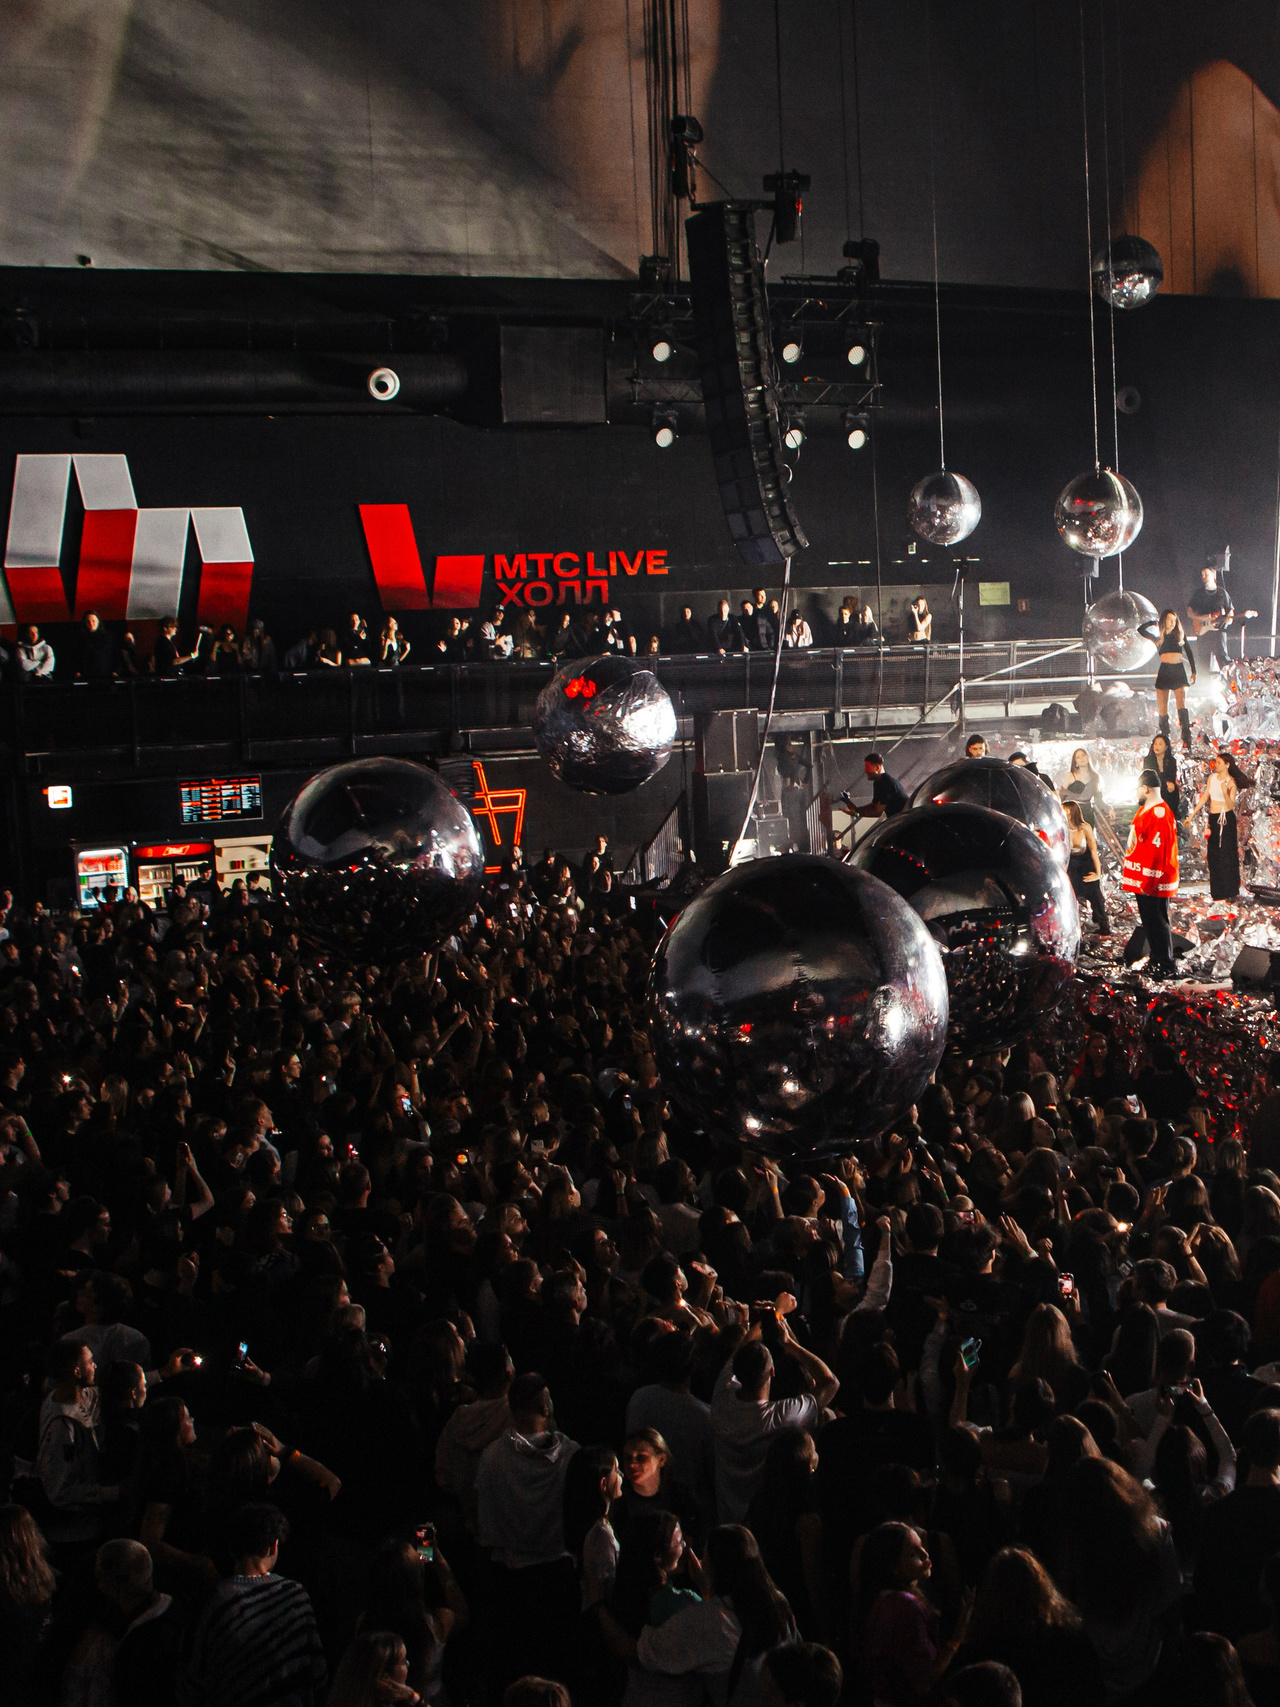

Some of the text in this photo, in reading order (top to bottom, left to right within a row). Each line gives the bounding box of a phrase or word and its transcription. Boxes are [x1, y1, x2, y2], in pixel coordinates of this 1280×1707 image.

[494, 549, 668, 579] МТС LIVE
[497, 580, 608, 606] ХОЛЛ
[1152, 831, 1161, 847] 4
